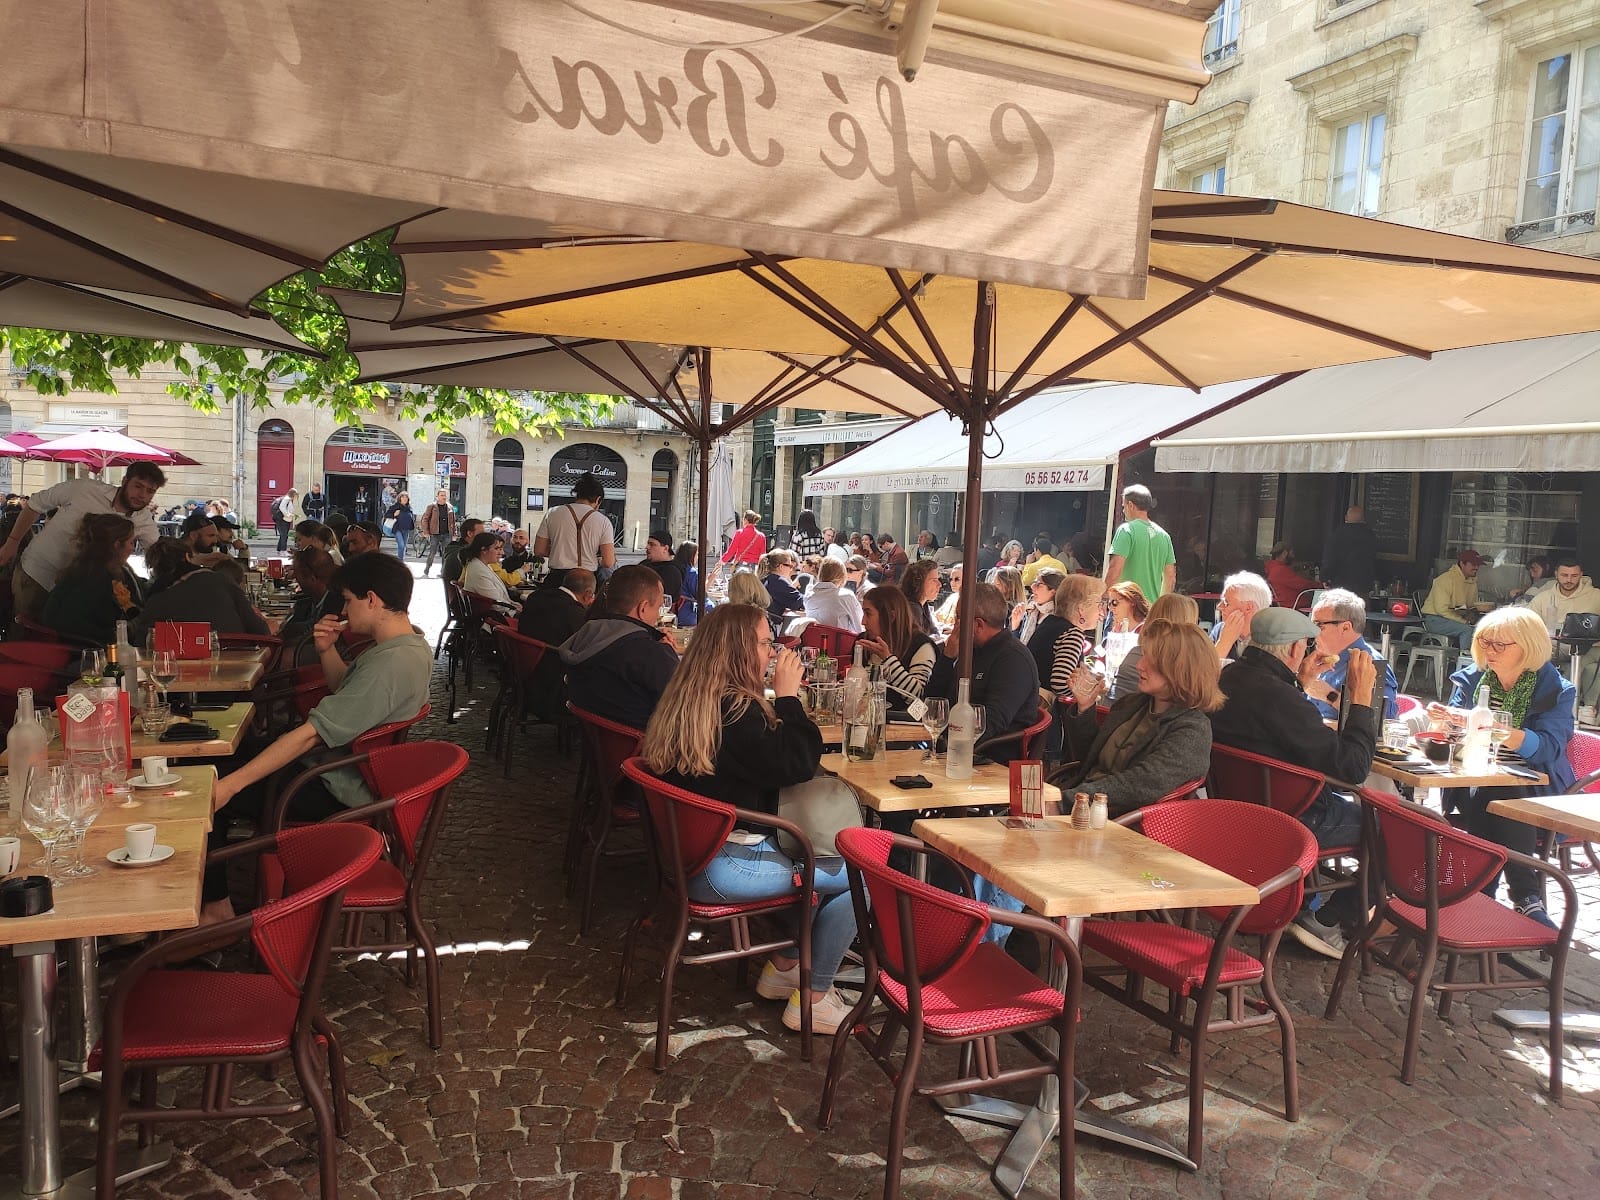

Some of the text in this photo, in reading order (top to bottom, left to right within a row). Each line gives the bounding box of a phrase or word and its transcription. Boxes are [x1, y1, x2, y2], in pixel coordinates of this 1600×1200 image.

[810, 481, 840, 492] RESTAURANT
[848, 479, 859, 490] BAR
[1025, 472, 1036, 485] 05
[1038, 471, 1048, 485] 56
[1051, 471, 1062, 484] 52
[1064, 470, 1075, 484] 42
[1078, 469, 1090, 484] 74
